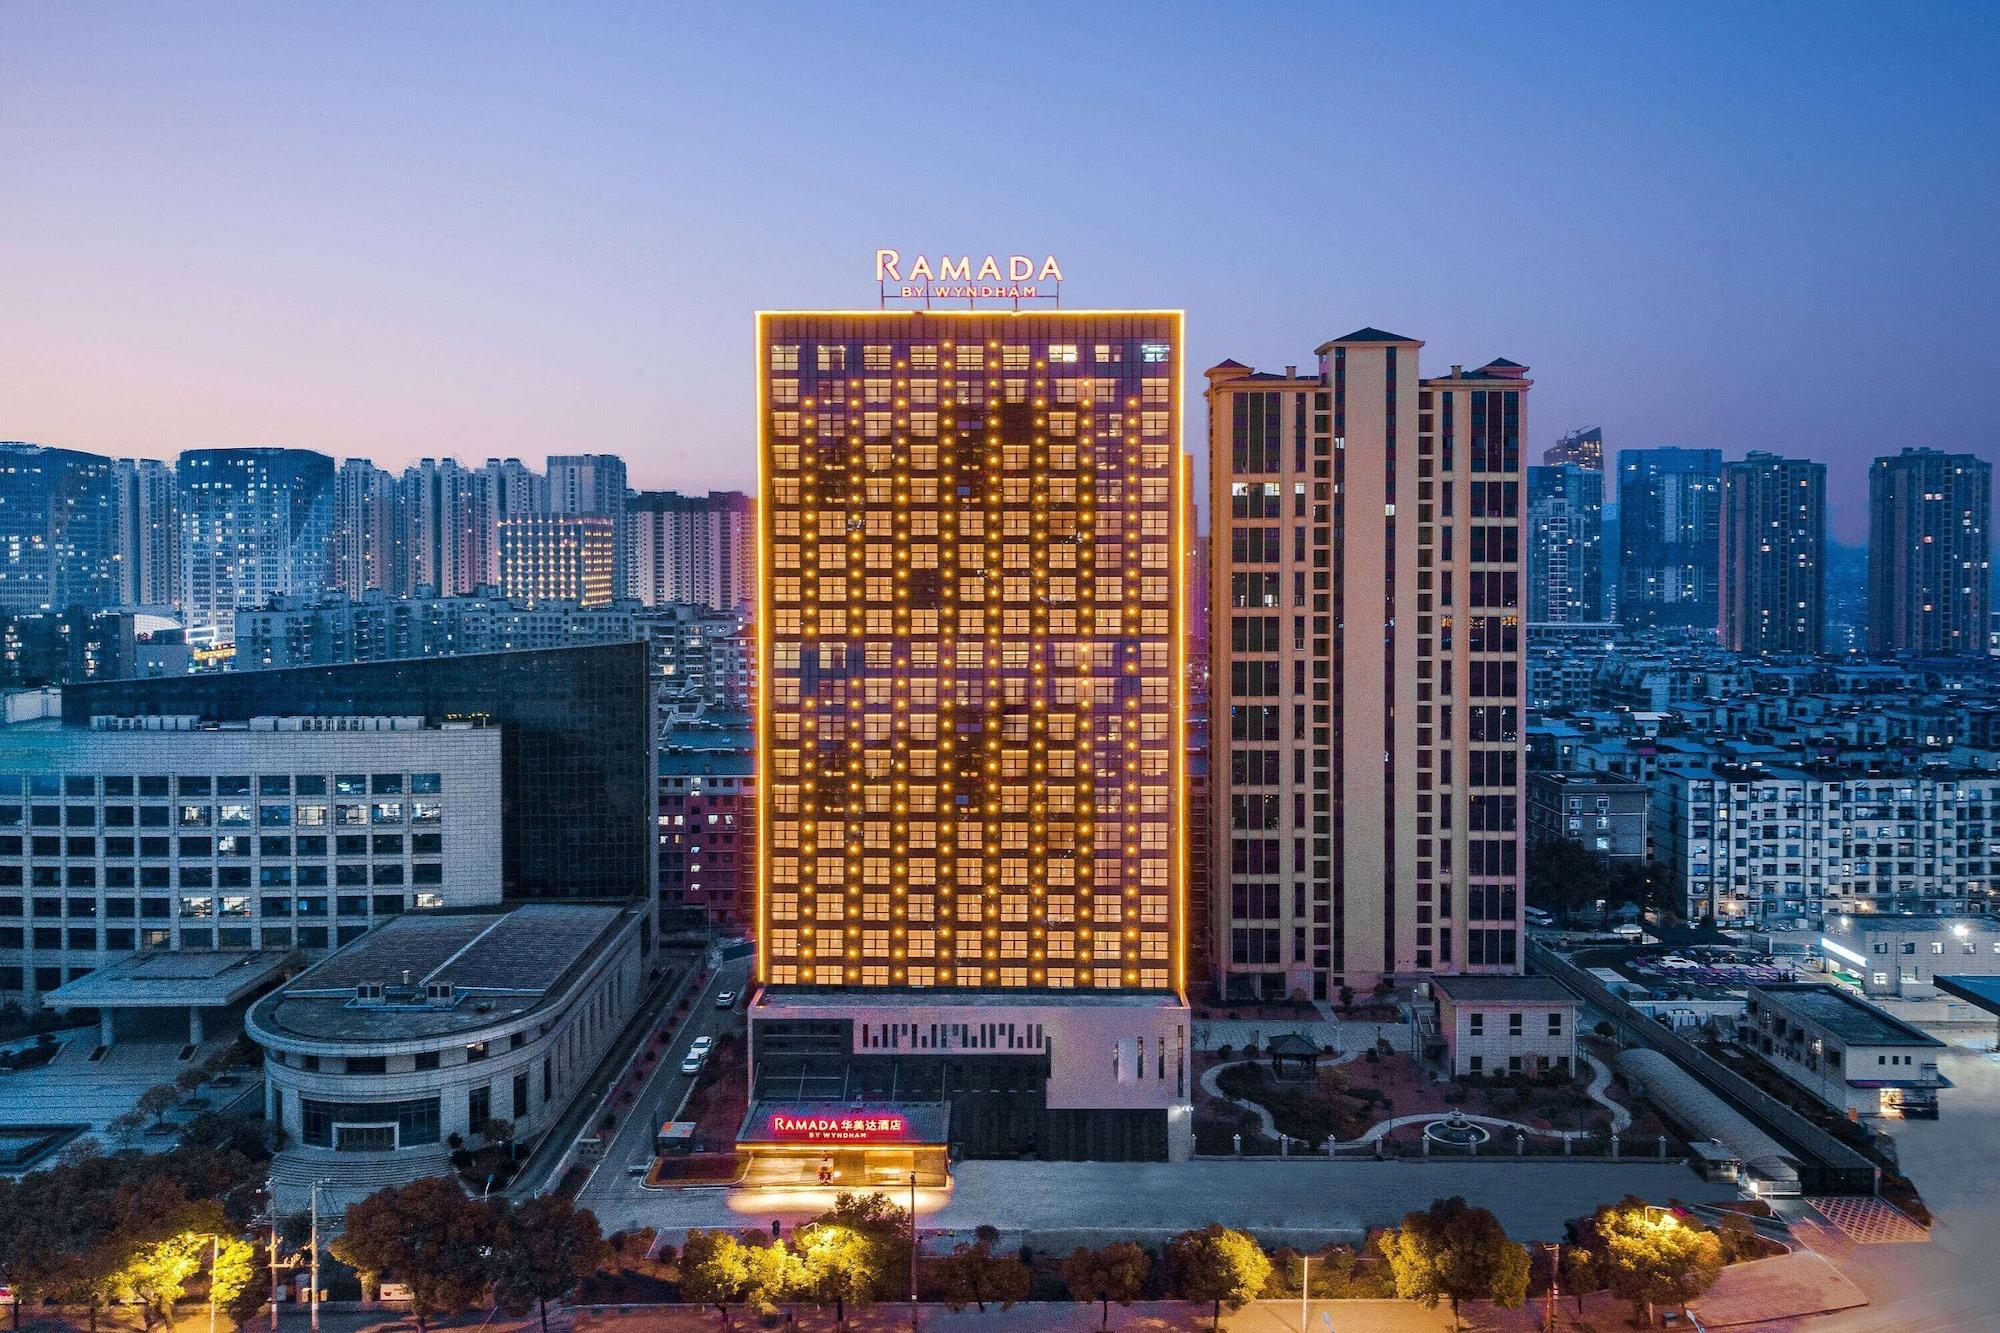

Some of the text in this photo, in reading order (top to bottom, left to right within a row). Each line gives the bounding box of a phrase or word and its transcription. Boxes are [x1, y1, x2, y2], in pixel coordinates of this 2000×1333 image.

[875, 249, 1063, 281] RAMADA
[901, 286, 1037, 298] BY WYNDHAM
[774, 1117, 902, 1131] RAMADA 华美达酒店
